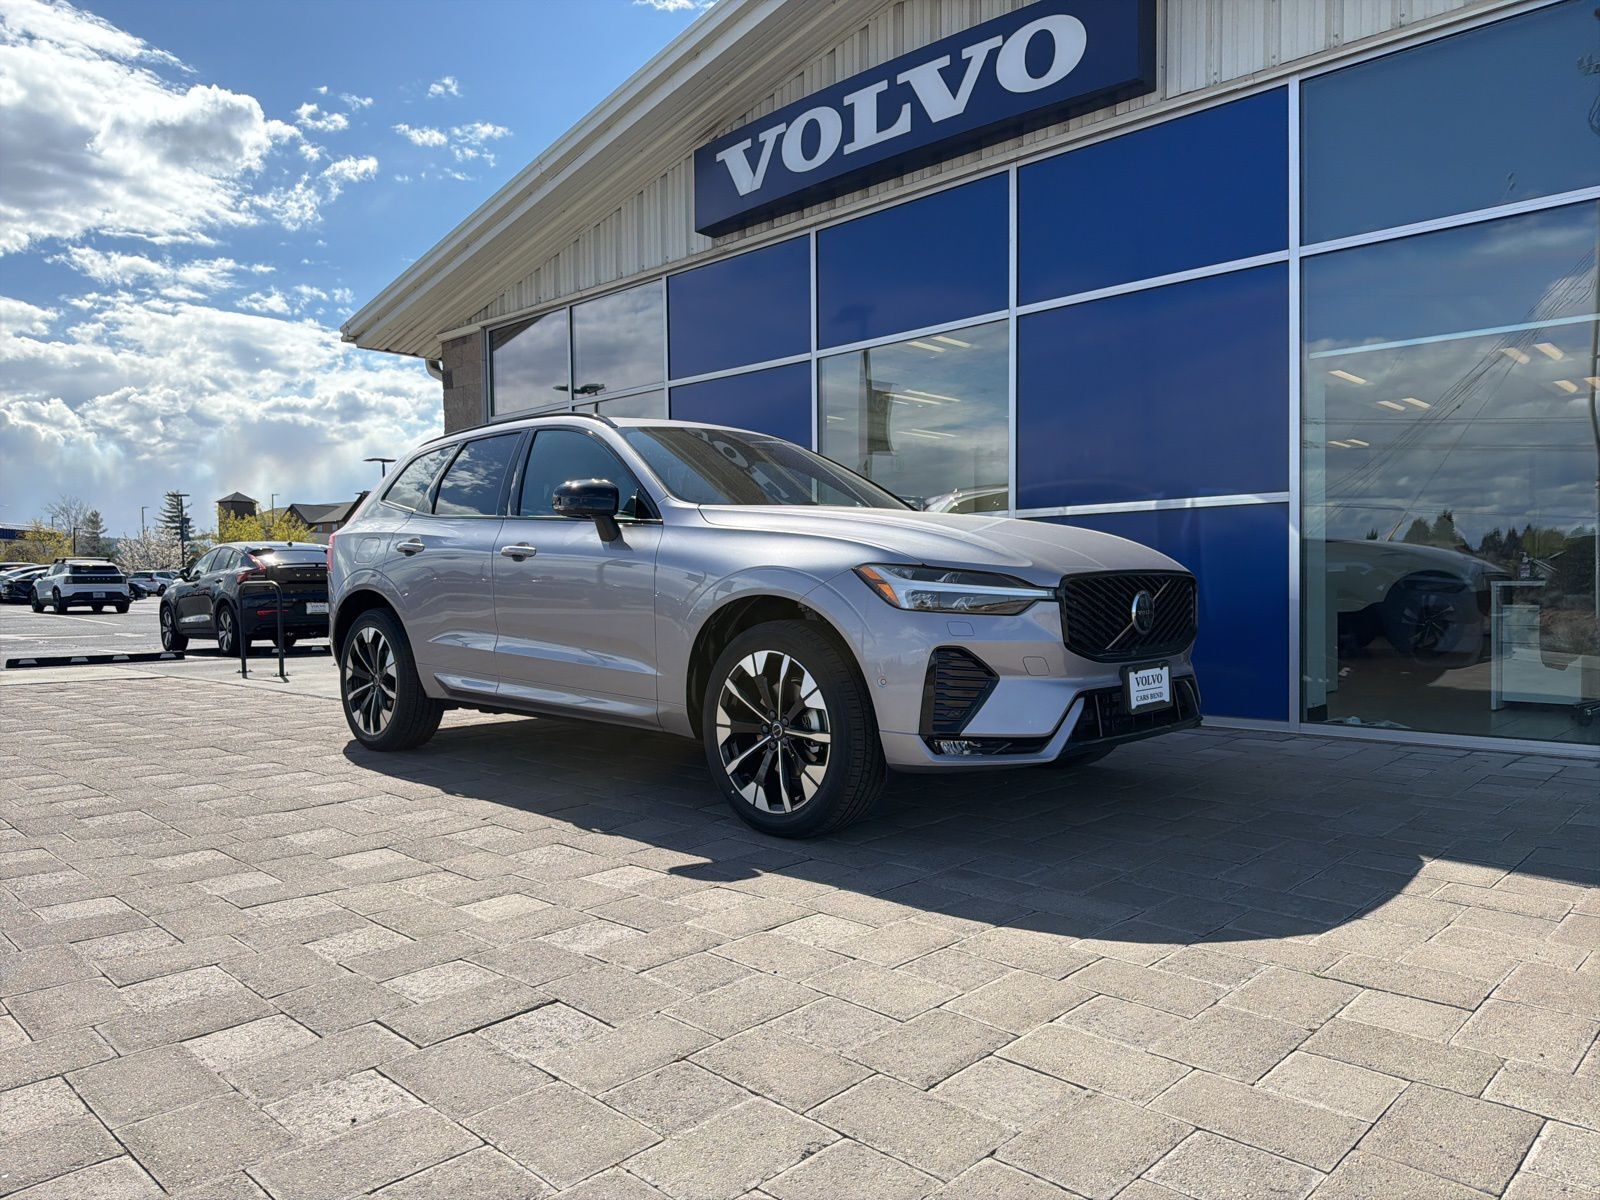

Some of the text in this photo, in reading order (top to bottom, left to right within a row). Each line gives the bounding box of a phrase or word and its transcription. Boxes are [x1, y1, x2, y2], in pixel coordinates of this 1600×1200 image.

[716, 14, 1087, 197] VOLVO
[1135, 673, 1163, 687] VOLVO
[1136, 691, 1164, 702] CARS BEND
